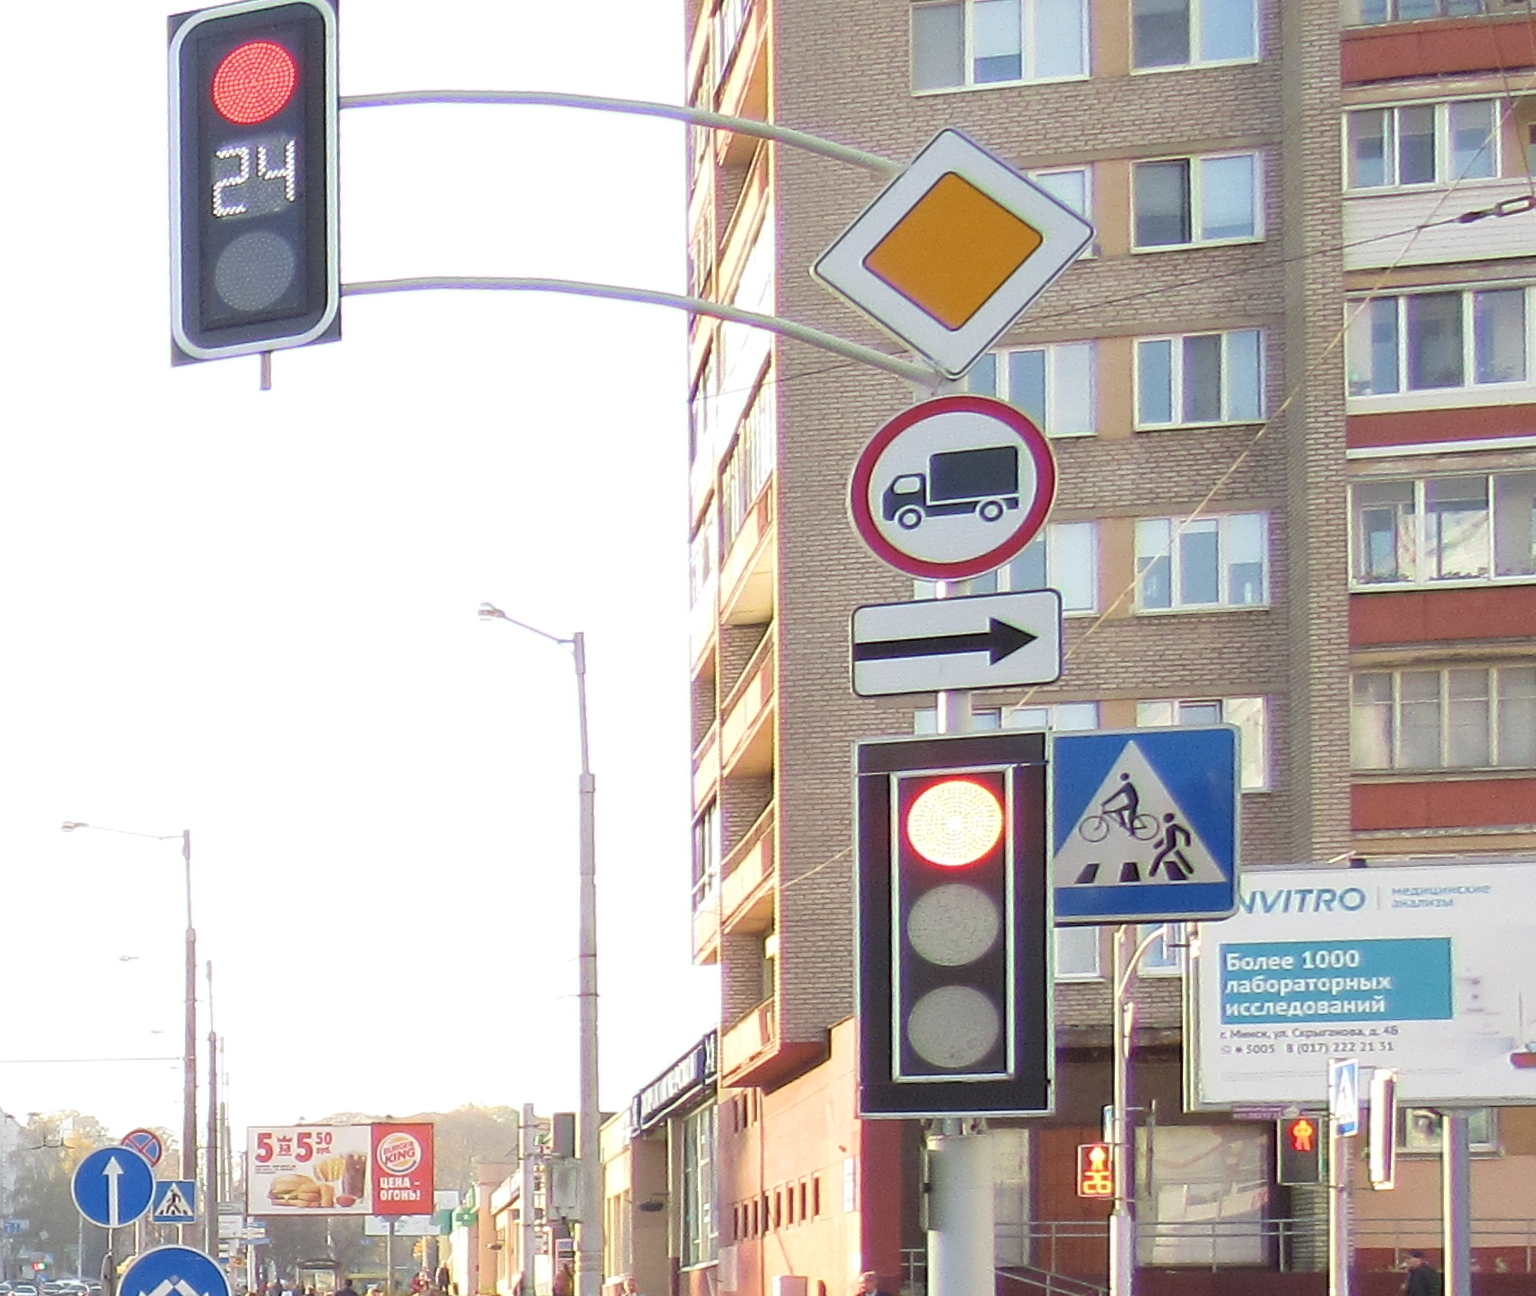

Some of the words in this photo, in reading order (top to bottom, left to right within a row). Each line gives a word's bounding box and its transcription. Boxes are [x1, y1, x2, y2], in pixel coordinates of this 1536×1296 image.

[211, 139, 297, 218] 24
[1239, 887, 1366, 914] NVITRO
[1226, 953, 1295, 971] Более
[1301, 949, 1360, 969] 1000
[1225, 975, 1392, 996] лабораторных
[1225, 996, 1386, 1017] исследований
[1297, 1042, 1329, 1055] (017)
[1332, 1042, 1356, 1053] 222
[1359, 1041, 1375, 1053] 21
[255, 1132, 274, 1163] 5
[295, 1131, 314, 1163] 5
[315, 1131, 333, 1145] 50
[385, 1148, 416, 1165] KING
[380, 1177, 411, 1190] ЦЕНА
[380, 1189, 421, 1201] ОГОНЬ!
